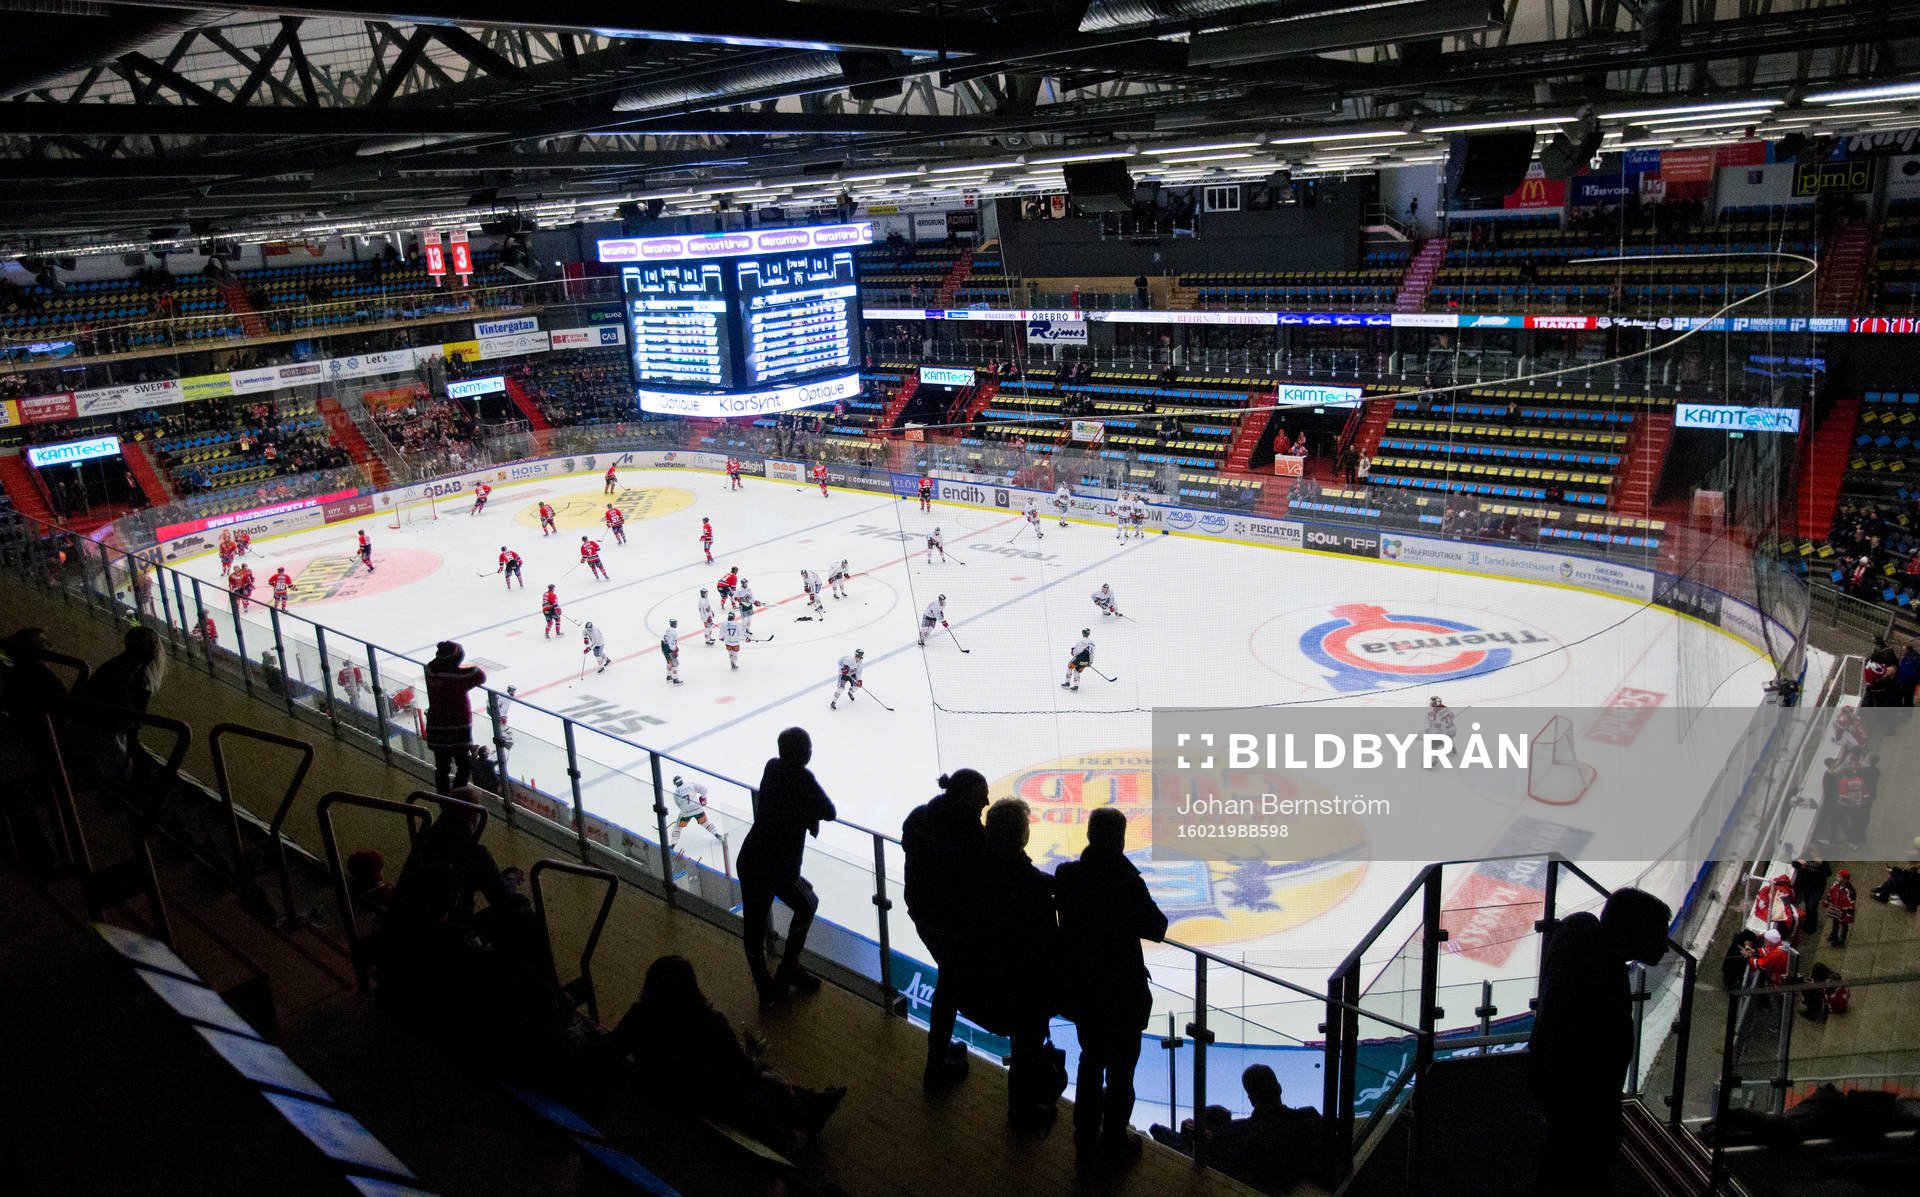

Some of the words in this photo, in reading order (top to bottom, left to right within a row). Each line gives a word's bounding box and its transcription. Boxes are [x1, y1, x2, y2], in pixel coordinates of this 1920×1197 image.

[427, 247, 442, 270] 13
[456, 246, 467, 269] 3
[479, 319, 535, 336] Vintergatan
[366, 353, 388, 364] Let's
[924, 370, 971, 383] KAMTech
[452, 381, 502, 395] KAMTech
[799, 381, 845, 403] Optique
[1285, 388, 1357, 403] KAMTech
[719, 394, 782, 412] KlarSynt
[37, 441, 114, 462] KAMTech
[511, 463, 550, 477] HOIST
[654, 461, 686, 469] VentPartner
[424, 480, 462, 498] ÖBAB
[853, 476, 890, 488] CONVENTUM
[1168, 510, 1193, 523] MOAB
[1200, 514, 1226, 526] MOAB
[1250, 523, 1300, 538] PISCATOR
[1306, 532, 1341, 546] SOUL
[1484, 555, 1556, 573] Tandvårdshuset
[727, 628, 737, 637] 17
[1361, 629, 1550, 655] Thermia
